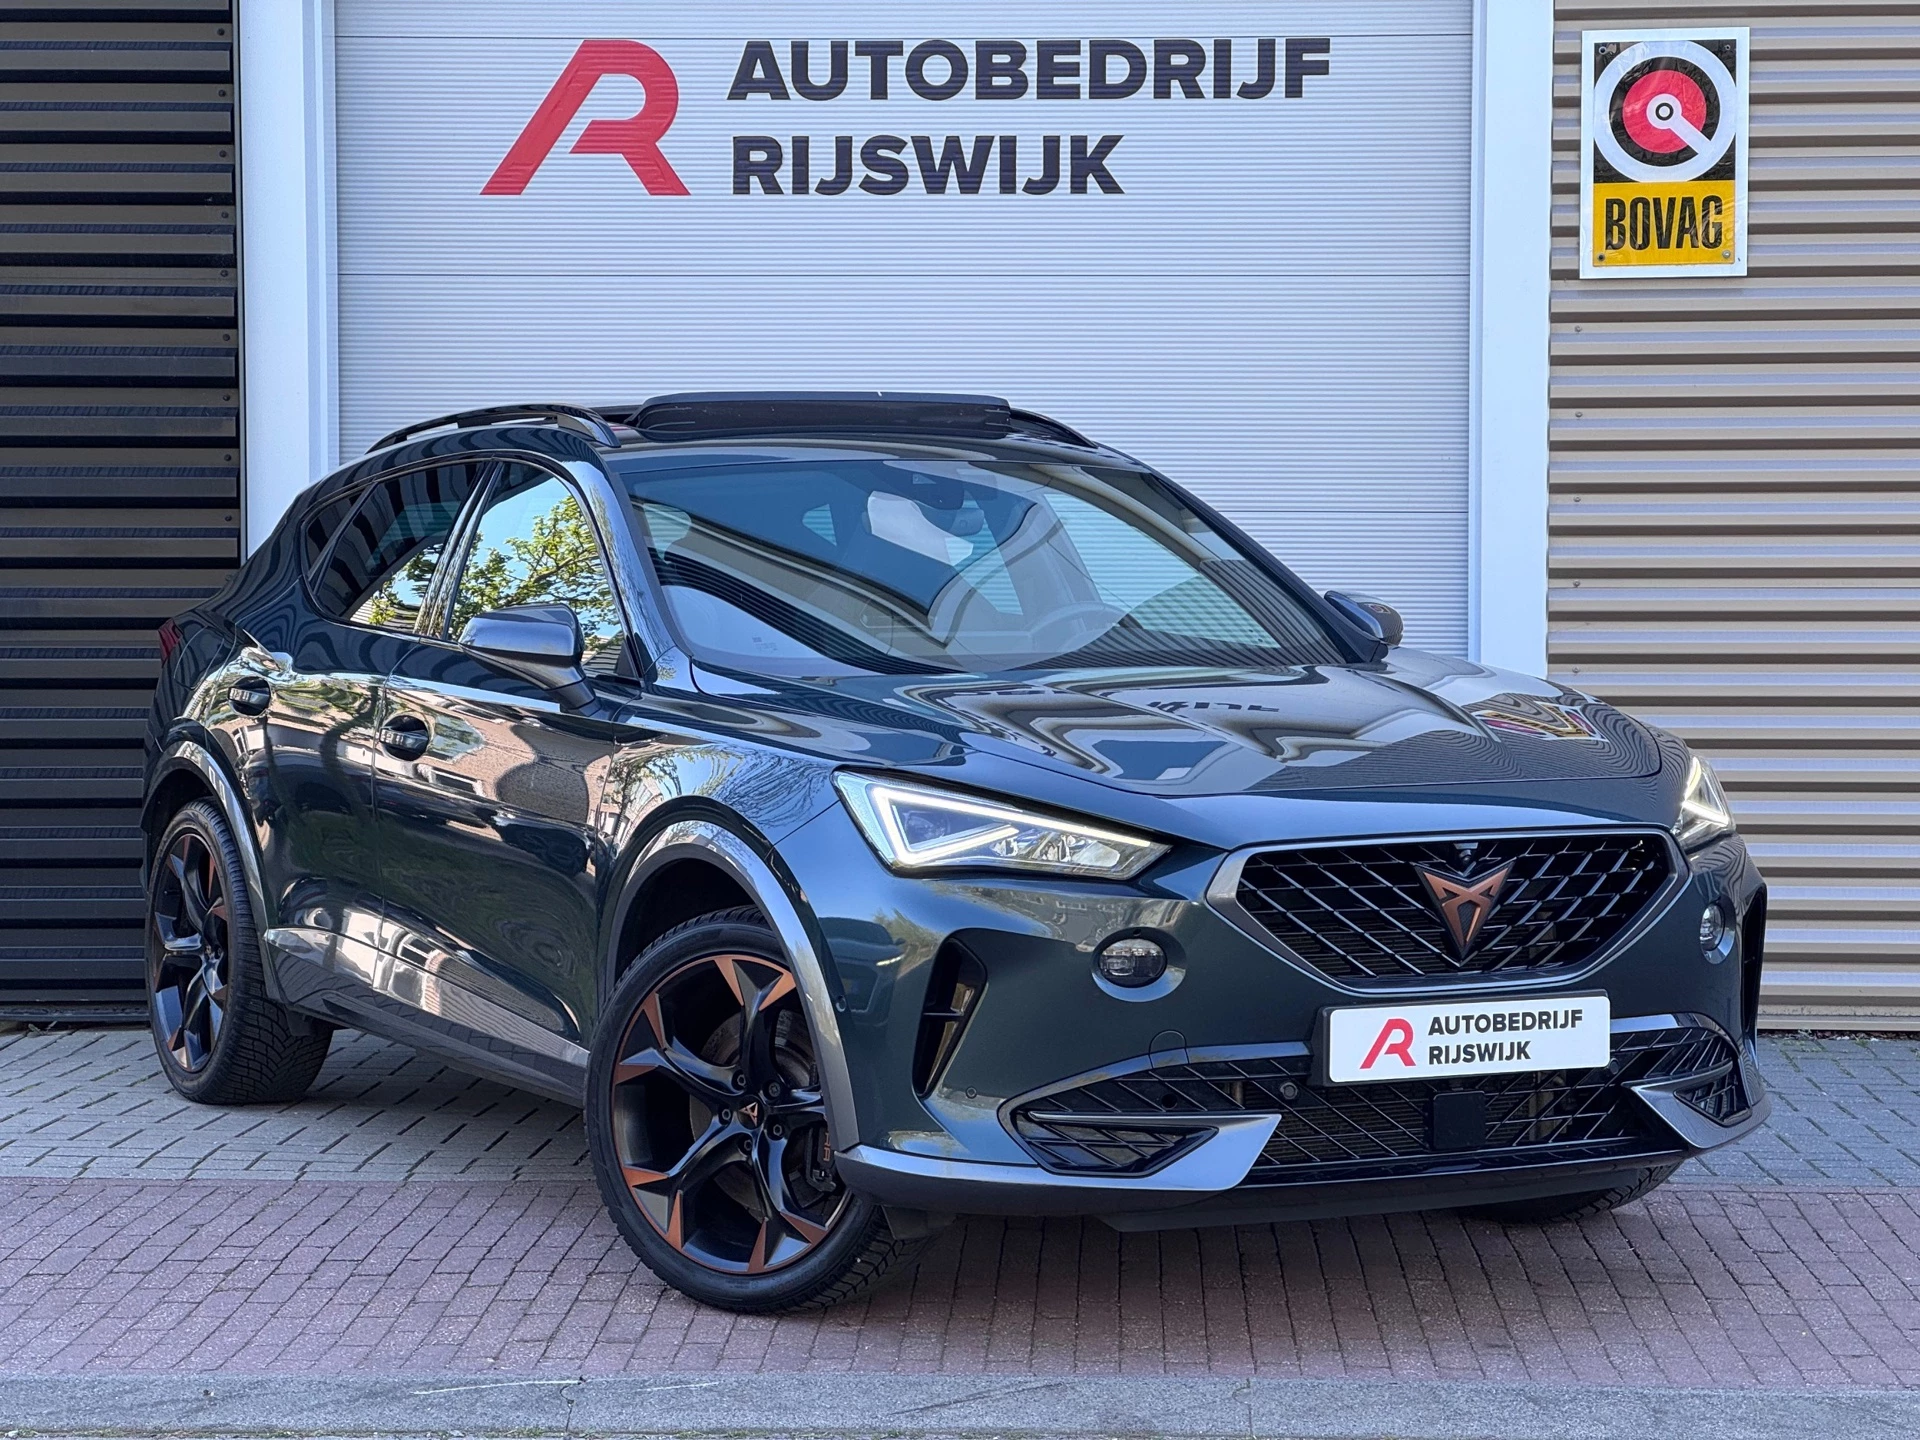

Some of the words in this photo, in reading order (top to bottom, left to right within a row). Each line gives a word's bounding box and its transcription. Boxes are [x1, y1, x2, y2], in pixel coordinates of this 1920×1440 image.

[727, 37, 1331, 102] AUTOBEDRIJF
[732, 134, 1124, 196] RIJSWIJK
[1605, 194, 1723, 251] BOVAG
[1428, 1009, 1583, 1036] AUTOBEDRIJF
[1428, 1040, 1532, 1065] RIJSWIJK
